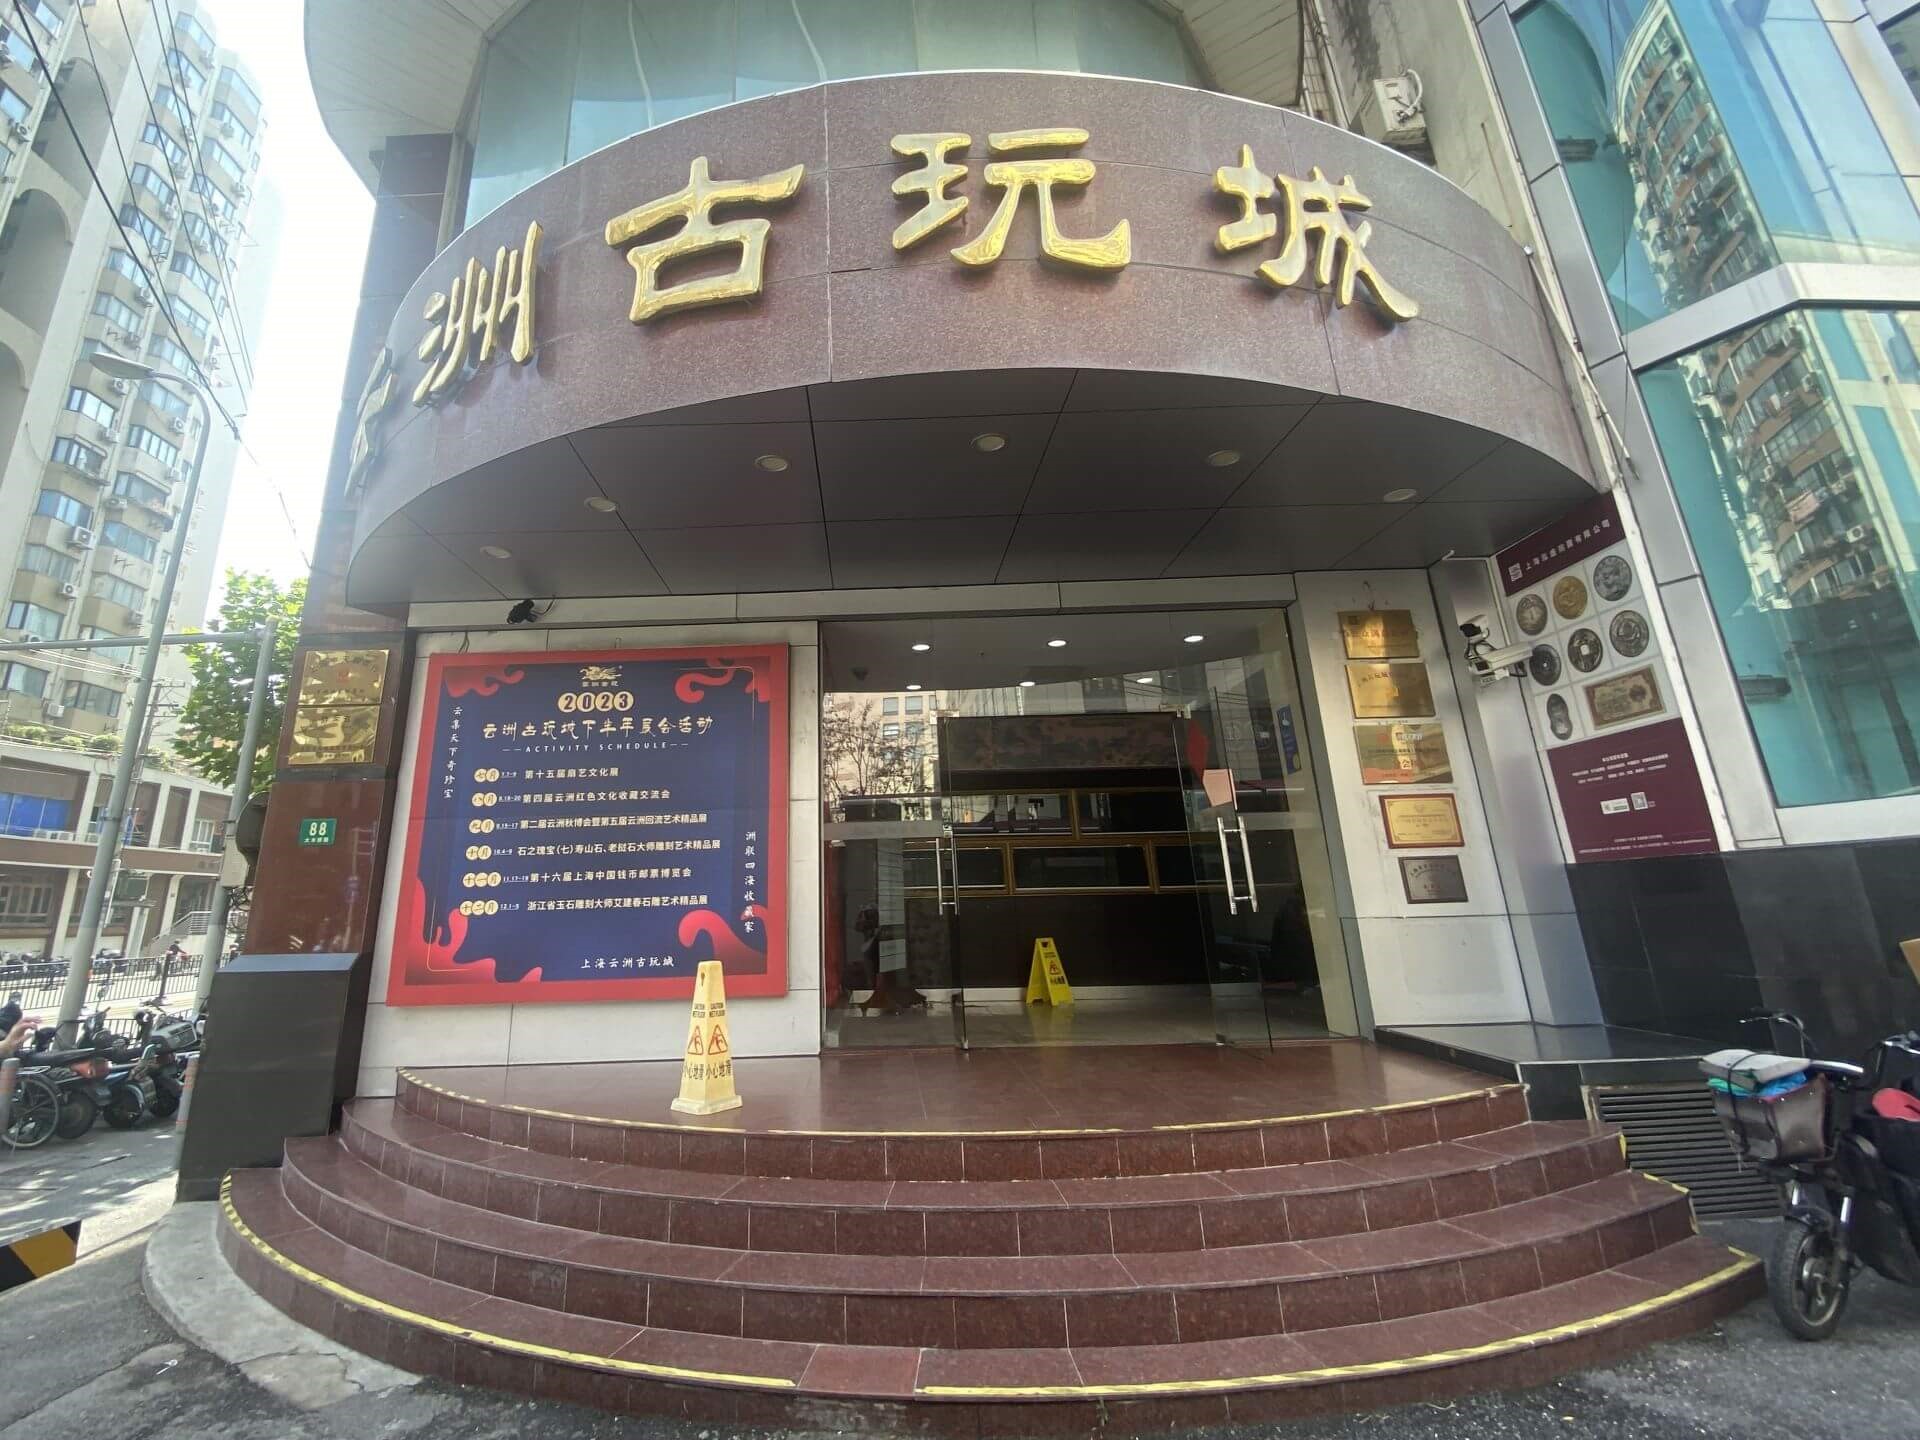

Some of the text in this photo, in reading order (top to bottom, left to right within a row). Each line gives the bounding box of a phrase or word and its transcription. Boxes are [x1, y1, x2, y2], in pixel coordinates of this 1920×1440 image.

[560, 692, 633, 712] 2023
[525, 741, 667, 754] ACTIVITY SCHEDULE
[522, 789, 672, 804] 第四届云洲红色文化收藏交流会
[308, 822, 328, 837] 88
[529, 867, 693, 883] 第十六届上海中国钱币邮票博览会
[580, 956, 675, 970] 上海云洲古玩城
